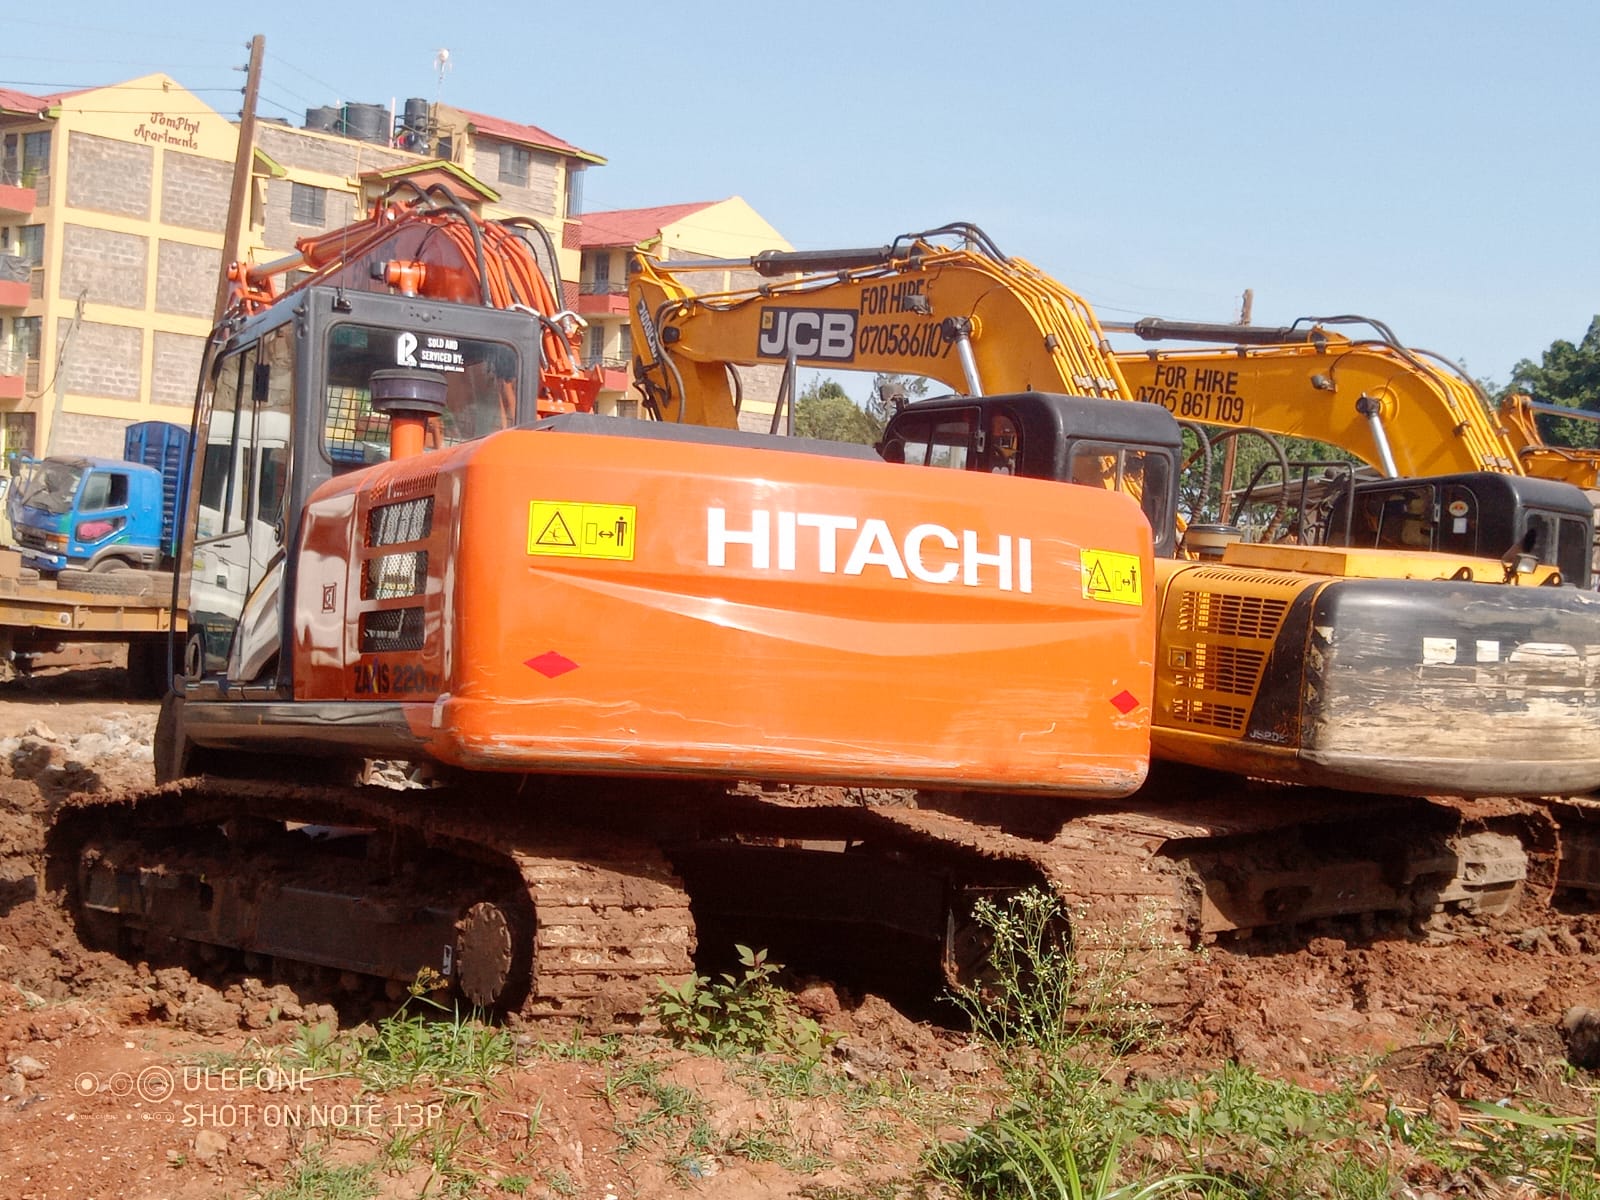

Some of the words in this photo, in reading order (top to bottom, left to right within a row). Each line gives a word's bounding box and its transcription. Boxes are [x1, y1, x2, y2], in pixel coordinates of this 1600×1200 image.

[134, 124, 198, 149] Apartments
[860, 284, 888, 316] FOR
[427, 337, 444, 349] SOLD
[445, 339, 458, 351] AND
[760, 311, 854, 358] JCB
[421, 350, 452, 363] SERVICED
[1154, 364, 1187, 389] FOR
[1194, 368, 1239, 395] HIRE
[707, 507, 1032, 594] HITACHI
